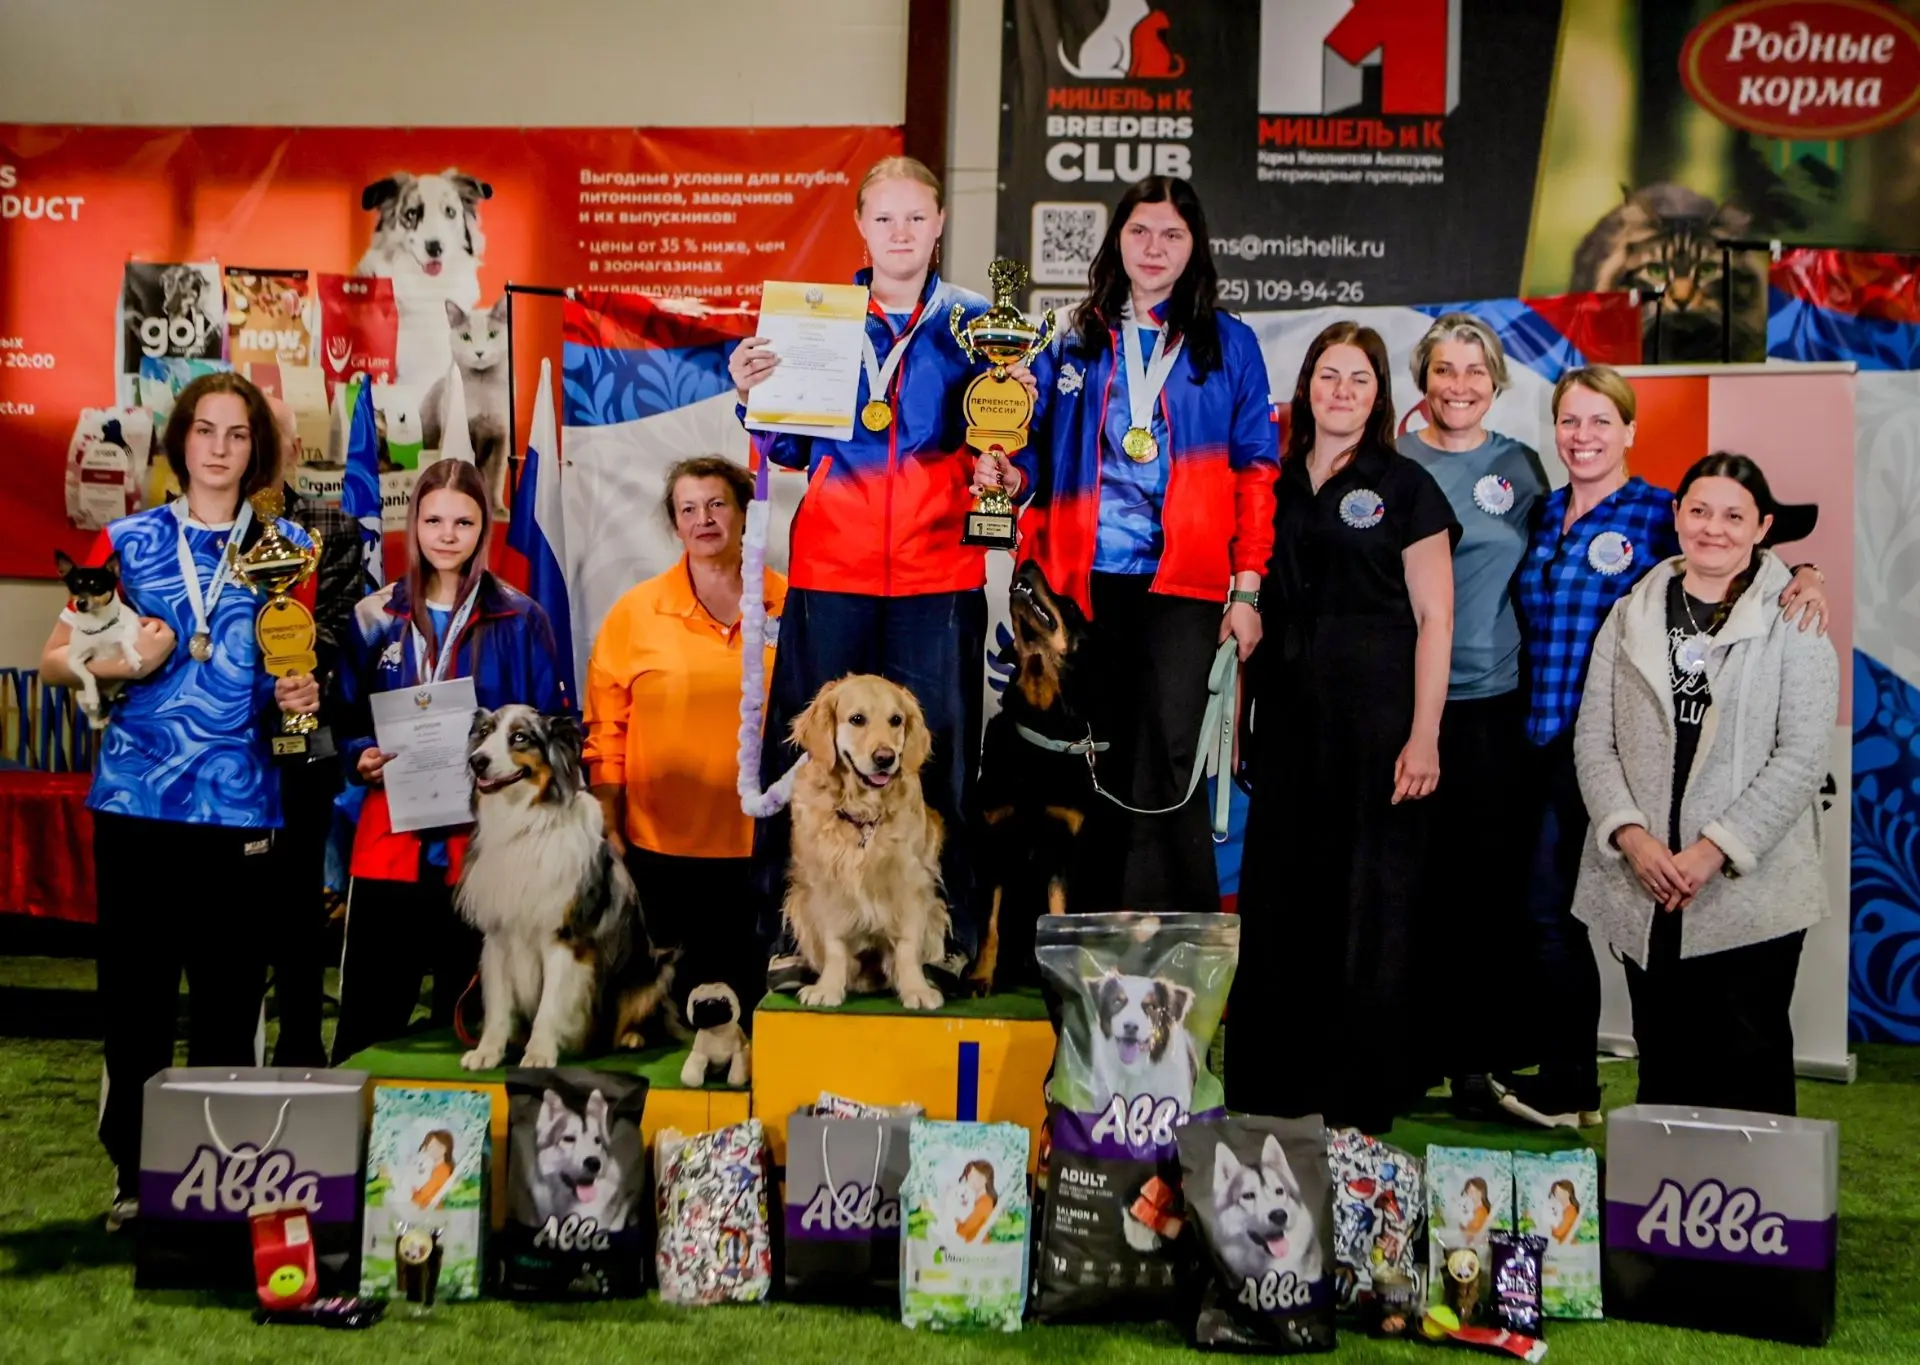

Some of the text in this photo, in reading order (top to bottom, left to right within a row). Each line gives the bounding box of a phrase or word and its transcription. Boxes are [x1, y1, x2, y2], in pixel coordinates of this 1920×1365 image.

[1726, 20, 1896, 64] Родные
[1047, 87, 1193, 111] МИШЕЛЬ и К
[1738, 74, 1883, 116] корма
[1046, 115, 1193, 138] BREEDERS
[1258, 118, 1444, 148] МИШЕЛЬ и К
[1045, 141, 1193, 183] CLUB
[580, 169, 849, 188] Выгодные условия для клубов,
[580, 192, 793, 207] питомников, заводчиков
[580, 212, 737, 227] и их выпускников:
[590, 237, 785, 256] цены от 35 % ниже, чем
[590, 260, 722, 273] в зоомагазинах
[1256, 279, 1365, 303] 109-94-26
[6, 352, 55, 369] 20:00
[1092, 1093, 1190, 1147] Авв
[1061, 1167, 1107, 1188] ADULT
[1056, 1204, 1090, 1221] SALMON
[1637, 1180, 1789, 1255] Авва
